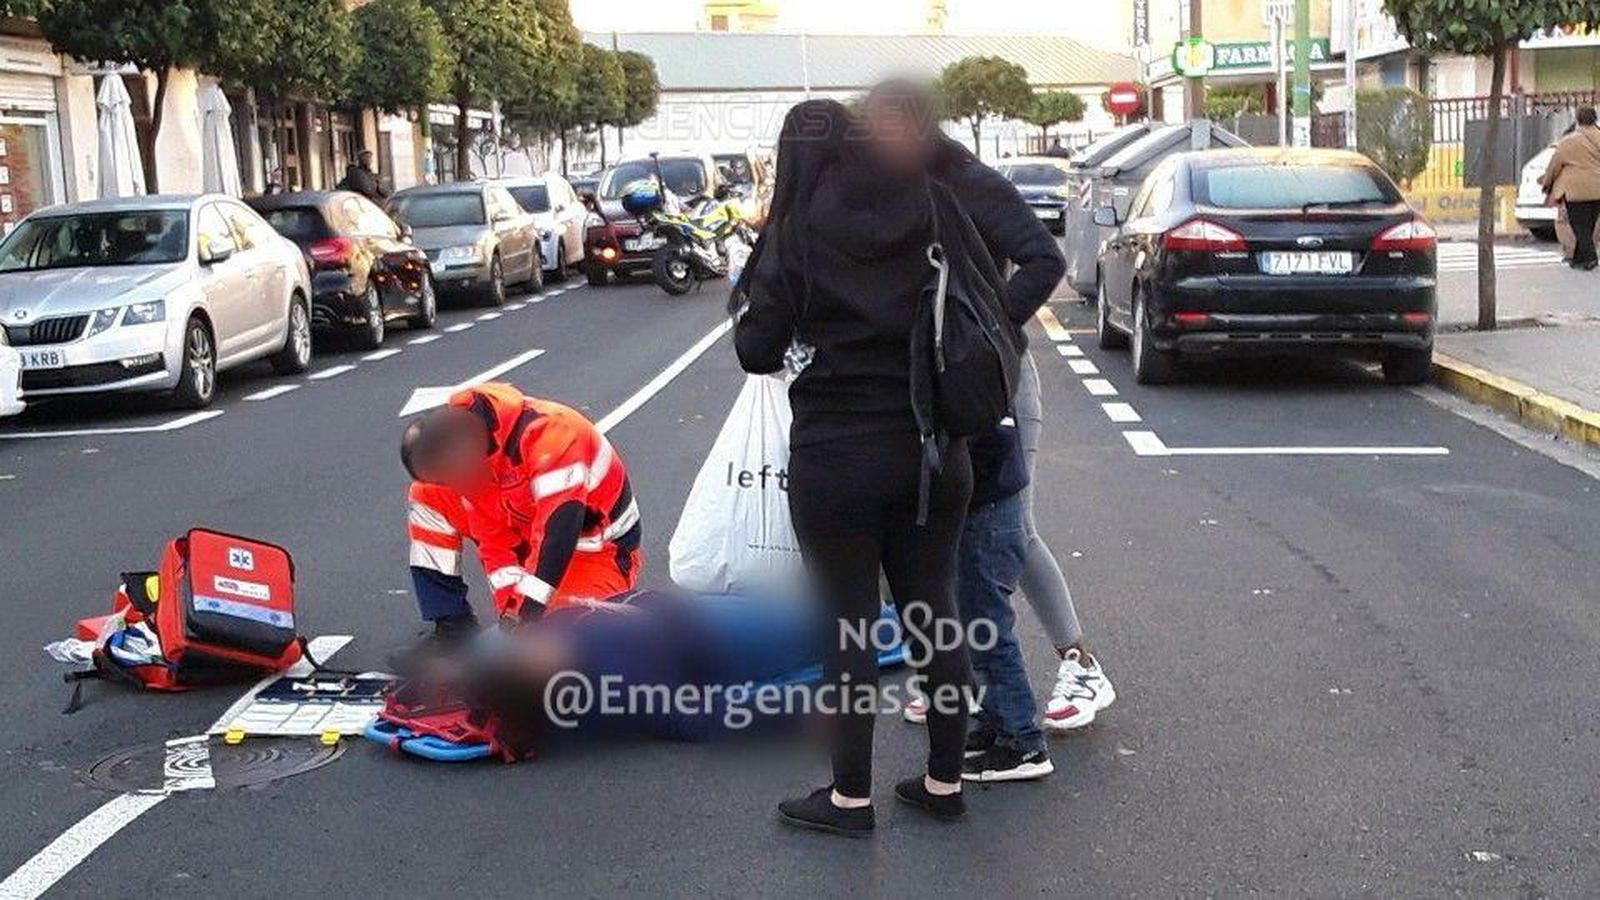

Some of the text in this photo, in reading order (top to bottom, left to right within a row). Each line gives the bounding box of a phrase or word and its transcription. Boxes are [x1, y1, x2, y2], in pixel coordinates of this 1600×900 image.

[1216, 41, 1325, 66] FARMCA
[30, 352, 59, 367] KRB
[726, 461, 789, 492] left
